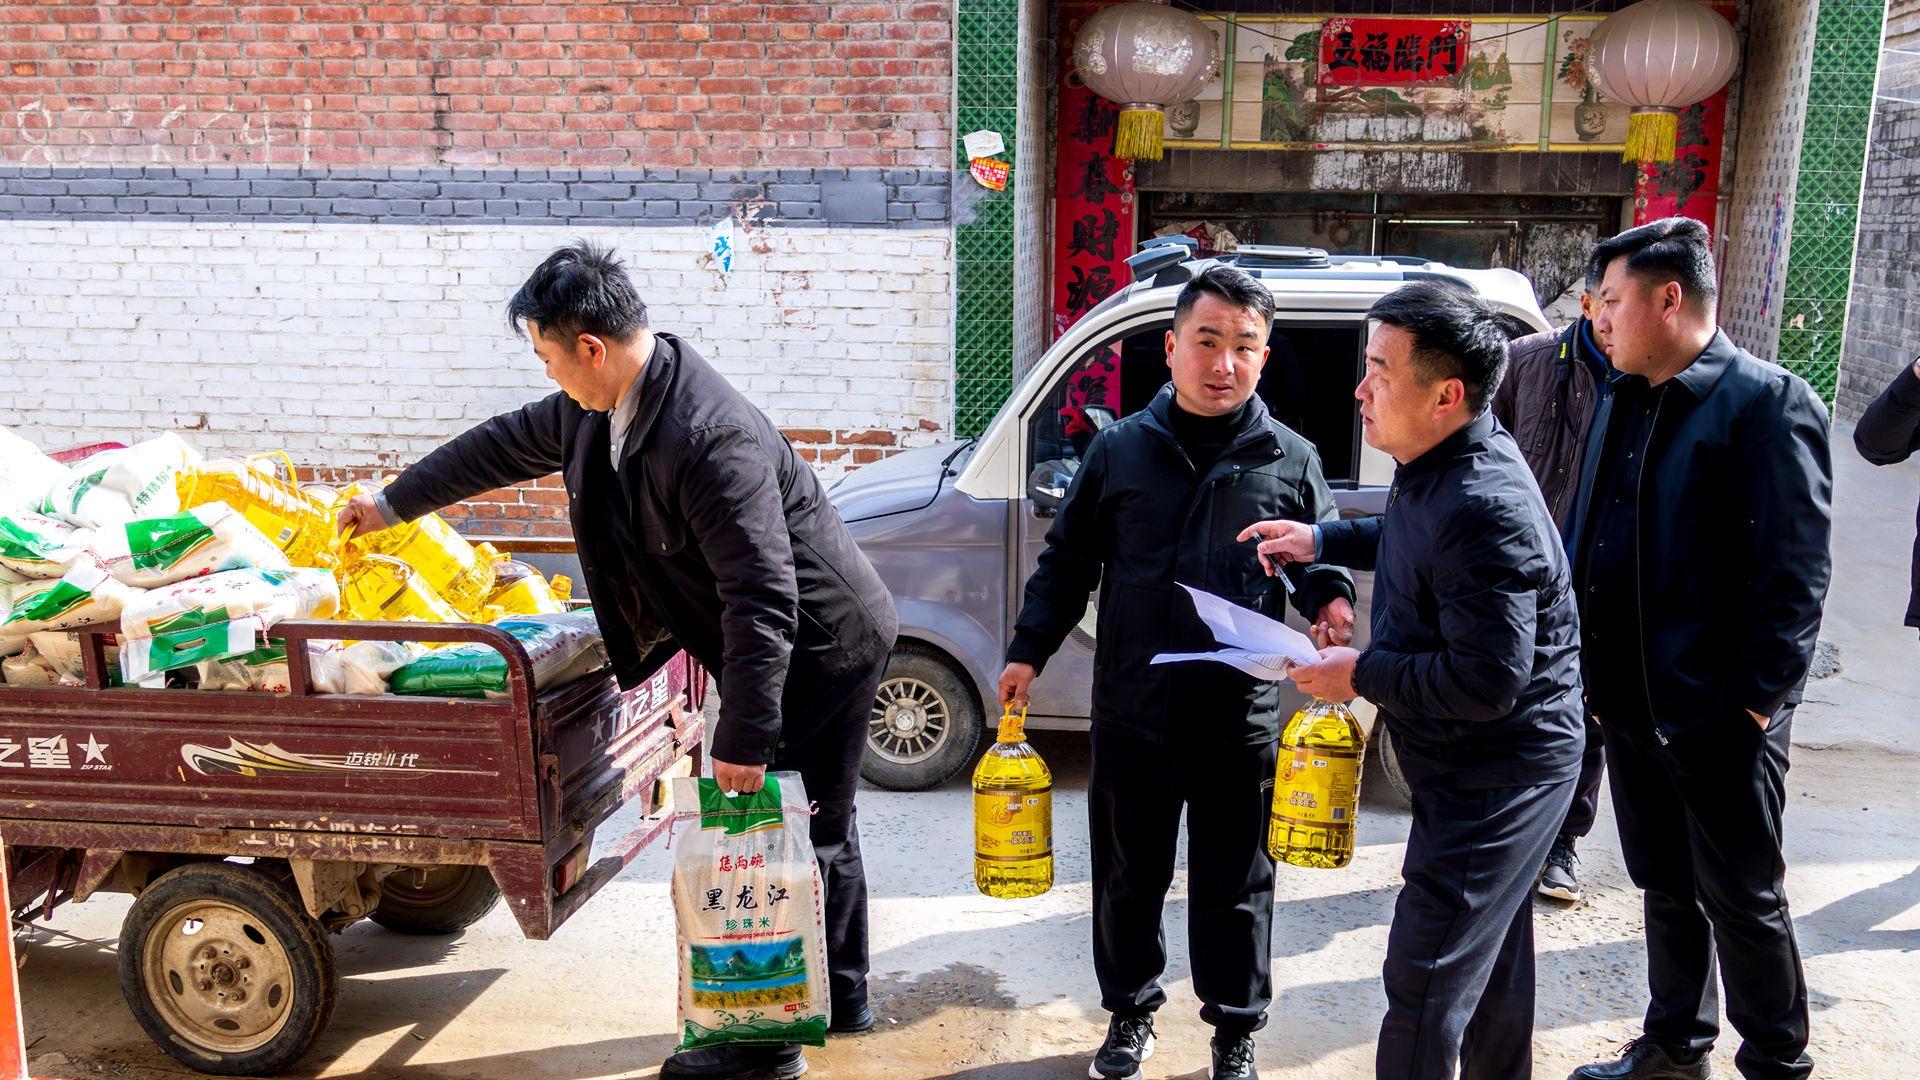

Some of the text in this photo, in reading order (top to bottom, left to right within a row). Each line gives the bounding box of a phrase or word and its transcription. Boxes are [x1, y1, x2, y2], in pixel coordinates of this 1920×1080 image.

[702, 884, 790, 911] 黑龙江
[725, 916, 771, 931] 珍珠米
